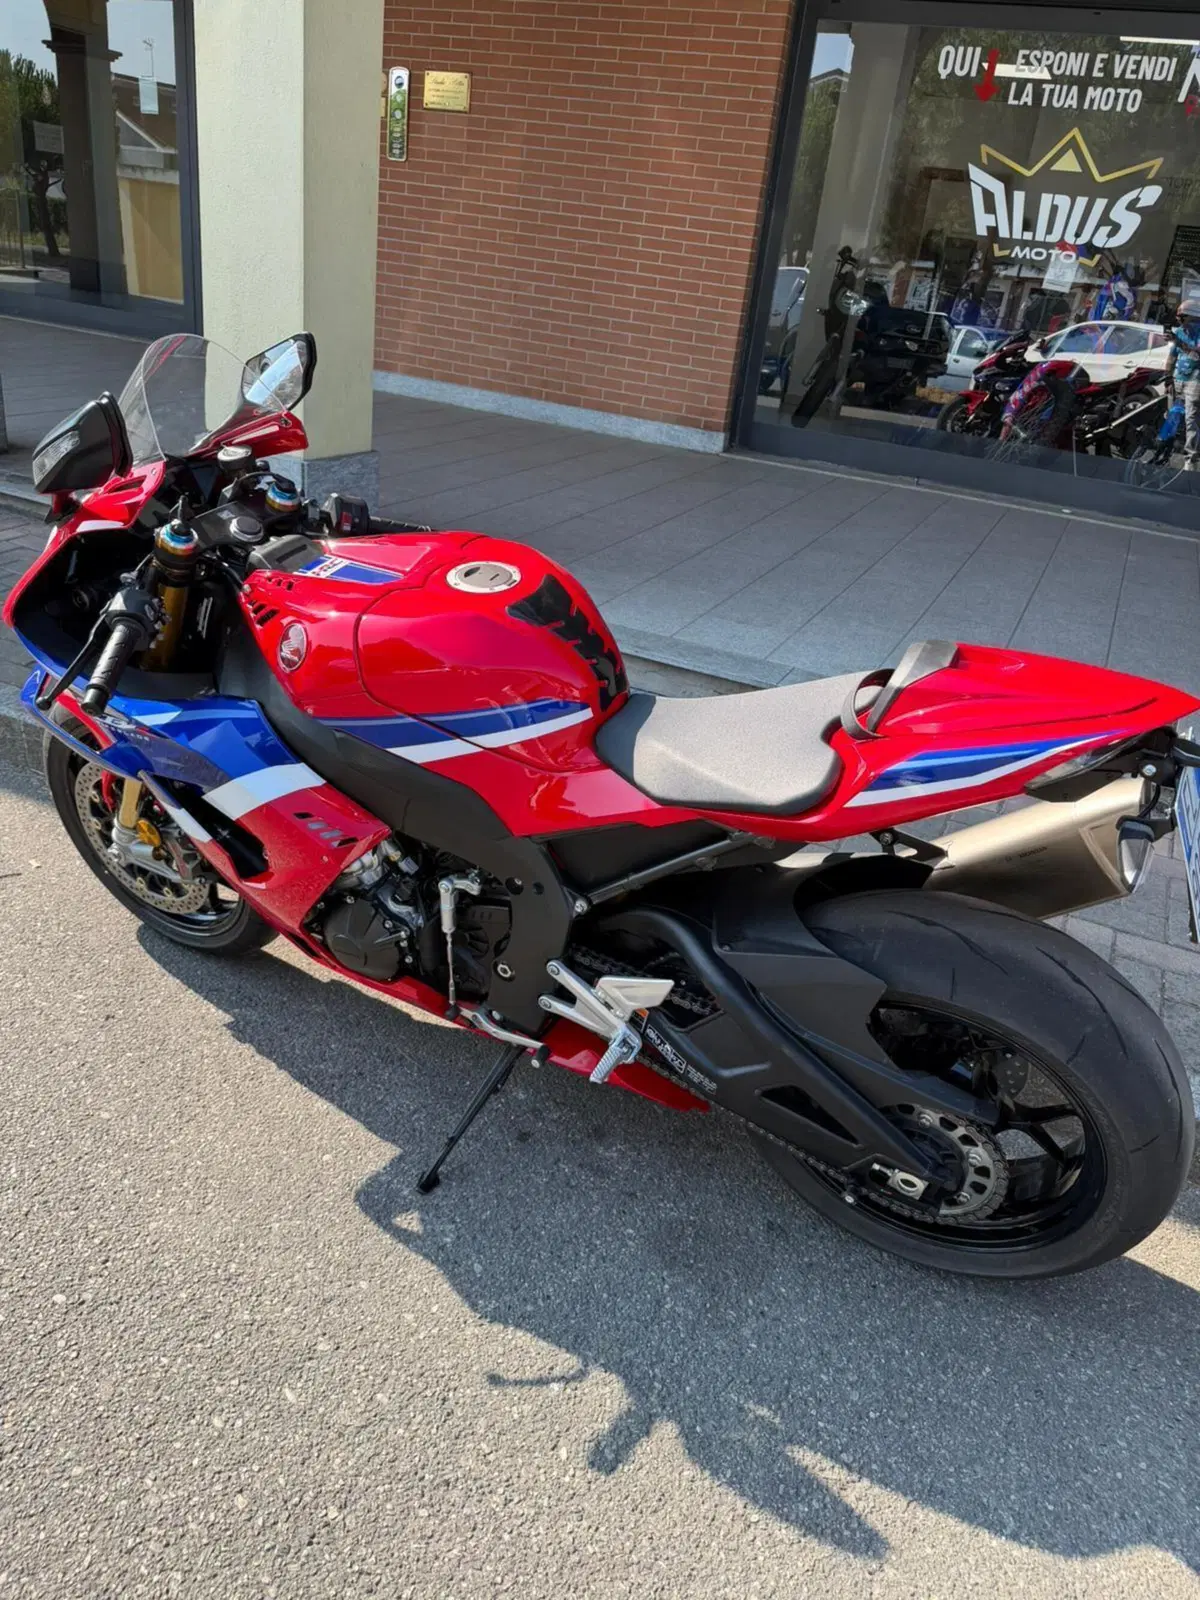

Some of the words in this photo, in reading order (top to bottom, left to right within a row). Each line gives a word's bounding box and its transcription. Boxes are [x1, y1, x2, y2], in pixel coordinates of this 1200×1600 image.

[938, 45, 982, 80] QUI
[1015, 49, 1090, 77] ESPONI
[1092, 53, 1109, 78] E
[1113, 54, 1178, 82] VENDI
[1007, 81, 1034, 107] LA
[1041, 83, 1079, 109] TUA
[1083, 86, 1143, 114] MOTO
[968, 162, 1163, 249] ALDUS
[1010, 245, 1077, 264] MOTO
